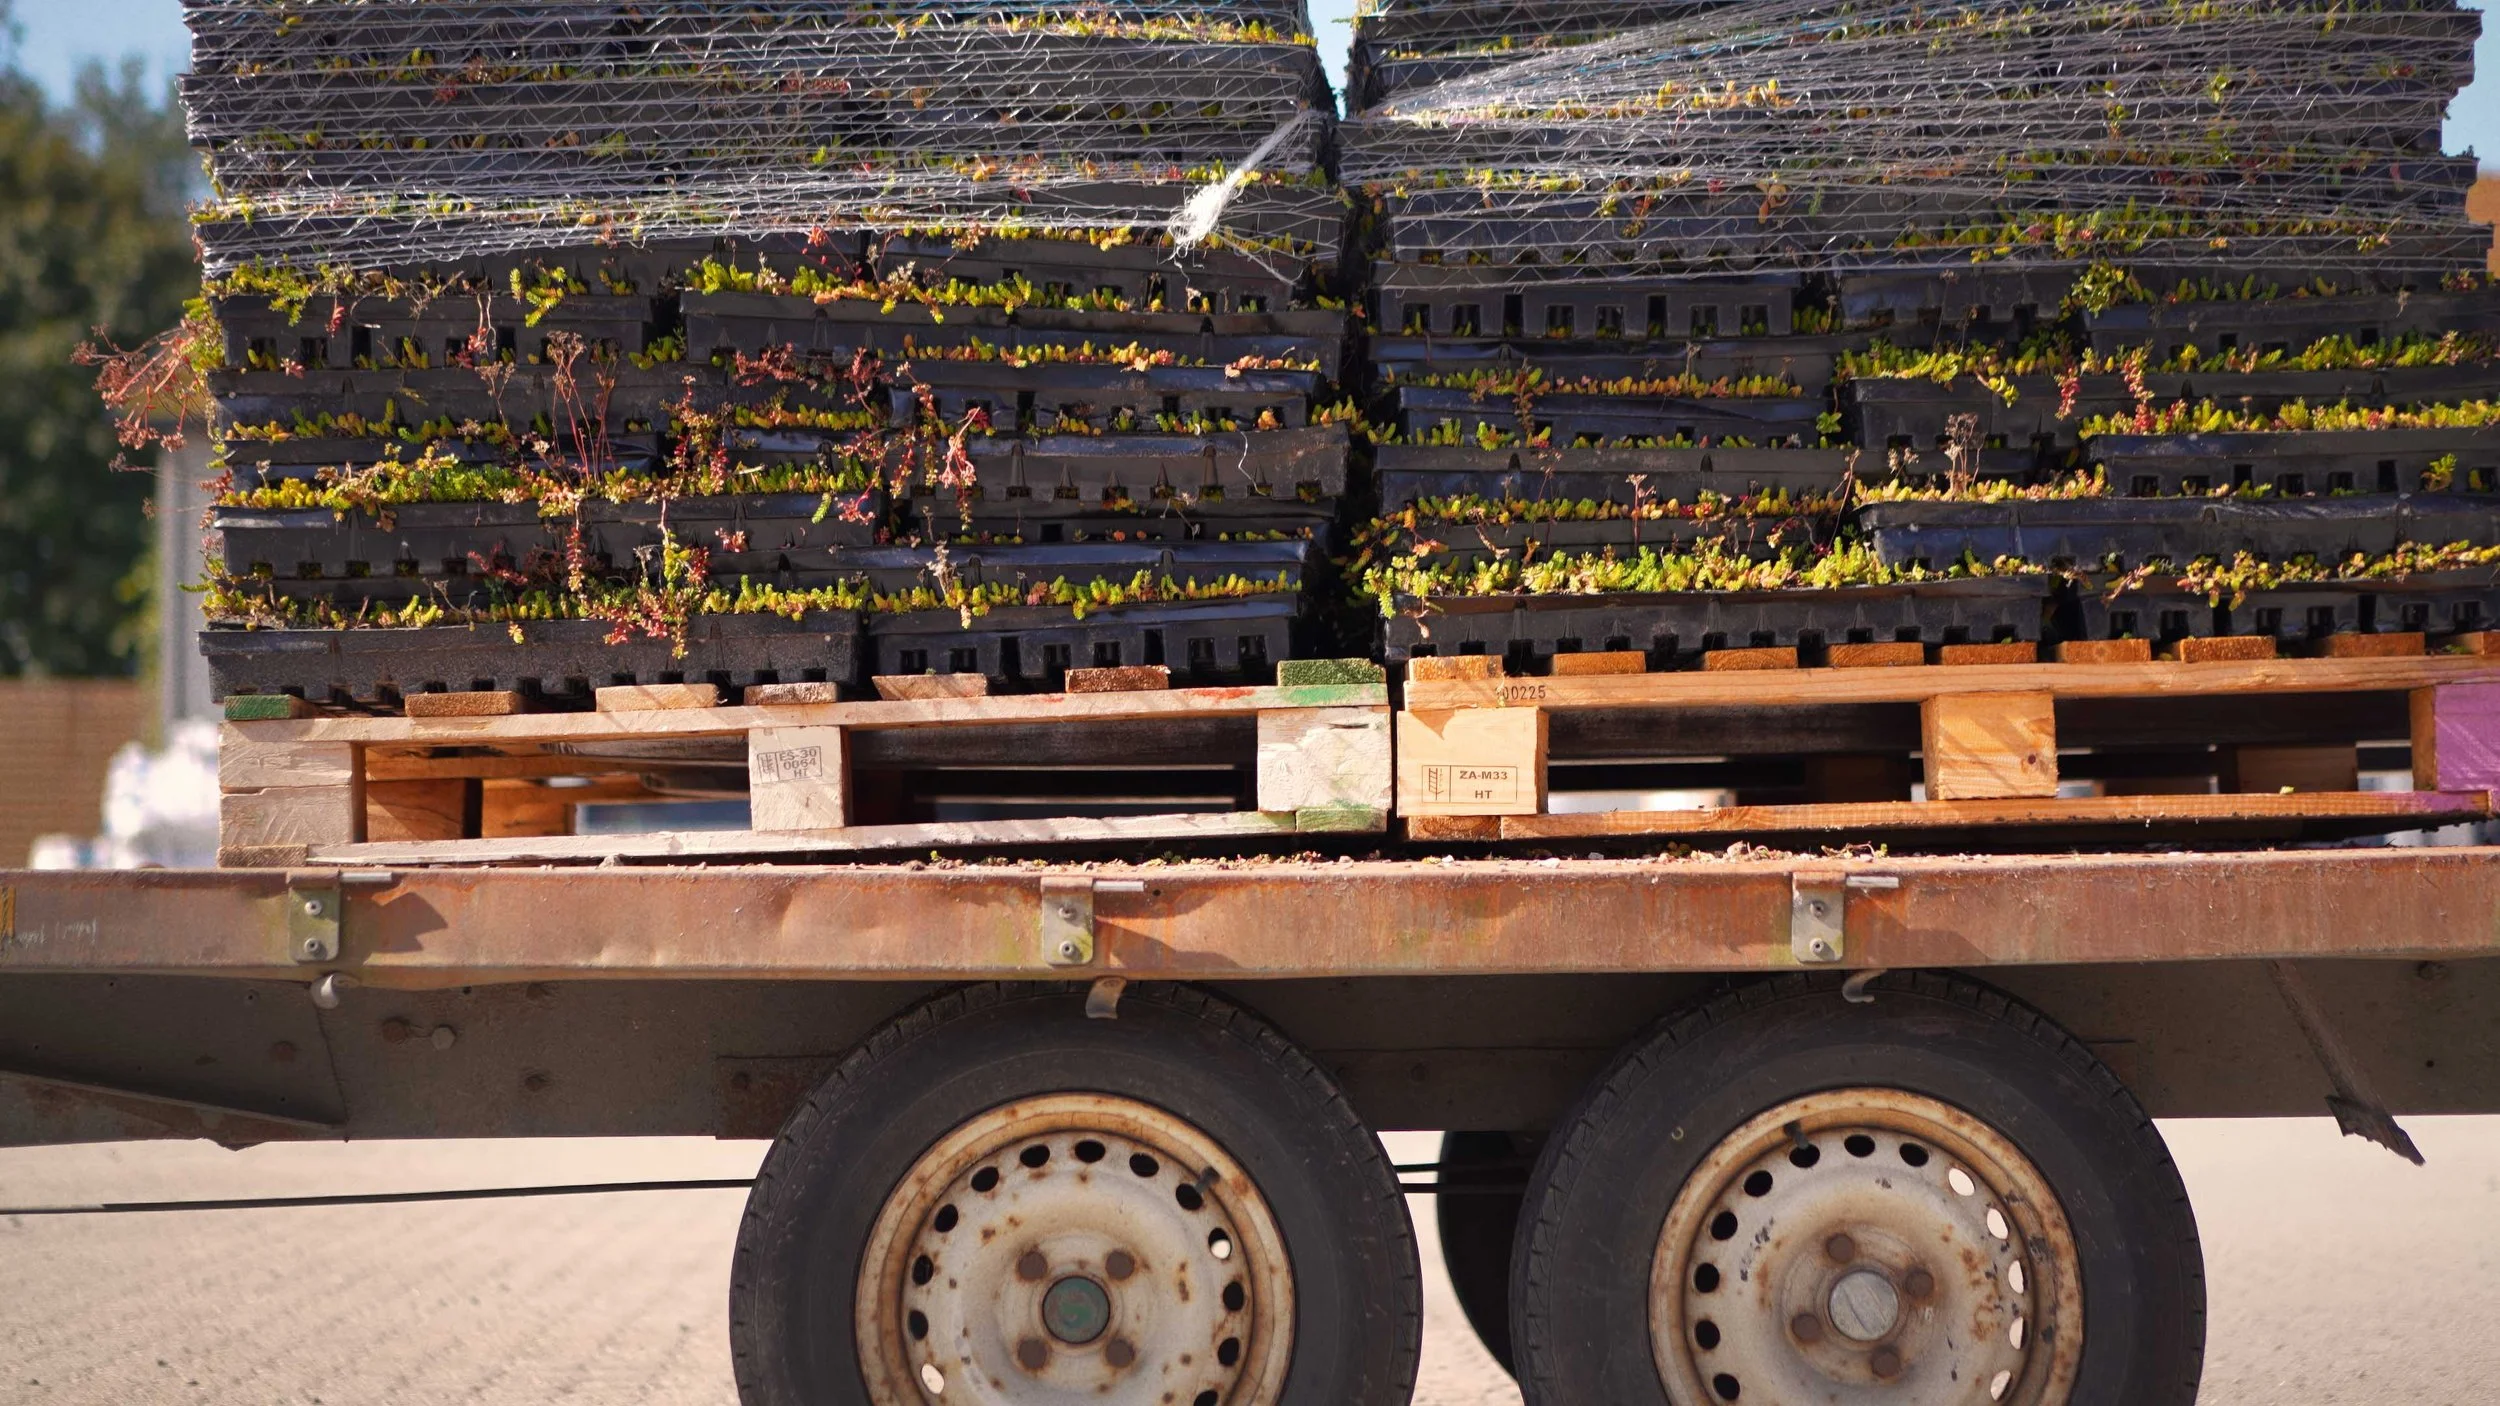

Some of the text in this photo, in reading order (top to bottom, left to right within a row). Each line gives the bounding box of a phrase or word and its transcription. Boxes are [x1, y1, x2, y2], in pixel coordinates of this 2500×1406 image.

[779, 748, 817, 761] ES-30
[783, 757, 817, 770] 0064
[1459, 770, 1508, 780] ZA-M33
[1474, 790, 1493, 799] HT
